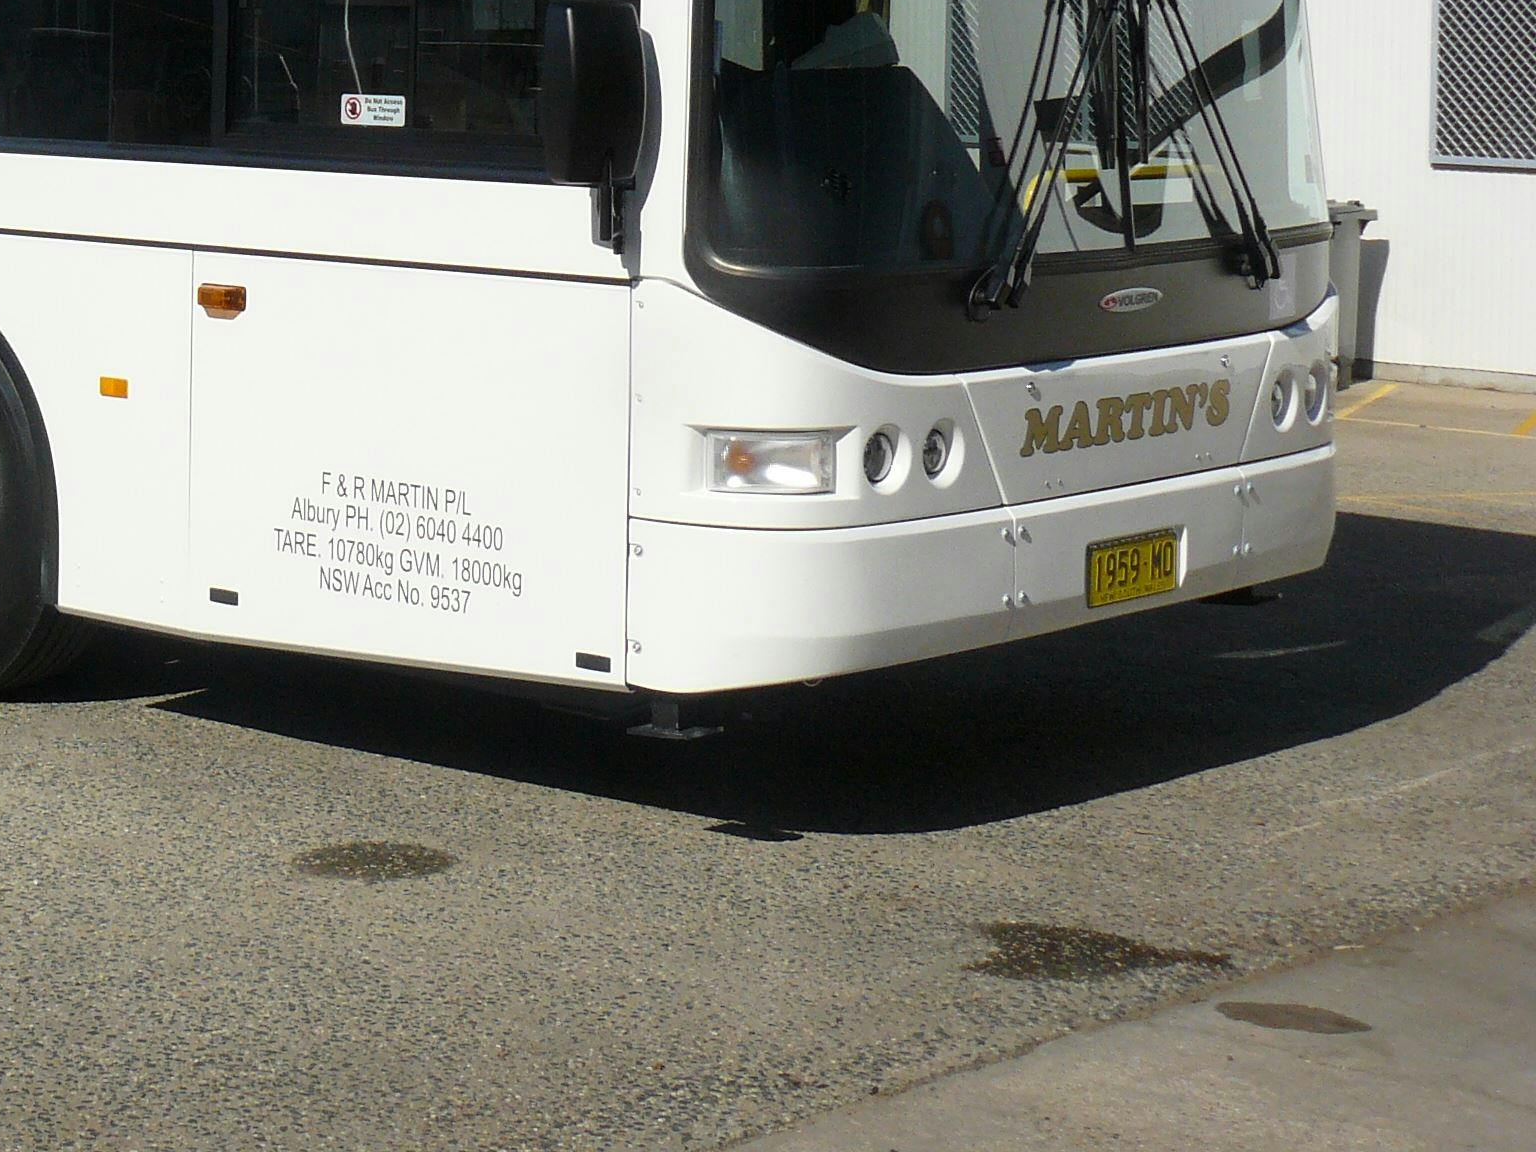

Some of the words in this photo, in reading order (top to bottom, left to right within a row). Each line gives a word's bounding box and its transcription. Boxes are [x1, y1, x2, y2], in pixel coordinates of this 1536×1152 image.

[1118, 291, 1161, 307] VOLGREN
[1019, 379, 1231, 457] MARTIN'S
[322, 471, 331, 495] F
[337, 474, 347, 497] &
[354, 476, 365, 500] R
[371, 478, 438, 511] MARTIN
[291, 497, 340, 531] Albury
[346, 505, 374, 531] PH.
[379, 509, 411, 542] (02)
[416, 516, 456, 544] 6040
[462, 522, 503, 551] 4400
[274, 528, 321, 558] TARE.
[328, 537, 394, 575] 10780kg
[400, 548, 444, 578] GVM.
[452, 557, 522, 597] 18000kg
[1096, 548, 1140, 592] 1959
[1151, 541, 1173, 580] MO
[320, 566, 360, 594] NSW
[363, 574, 392, 601] Acc
[398, 579, 424, 607] No.
[431, 585, 471, 614] 9537
